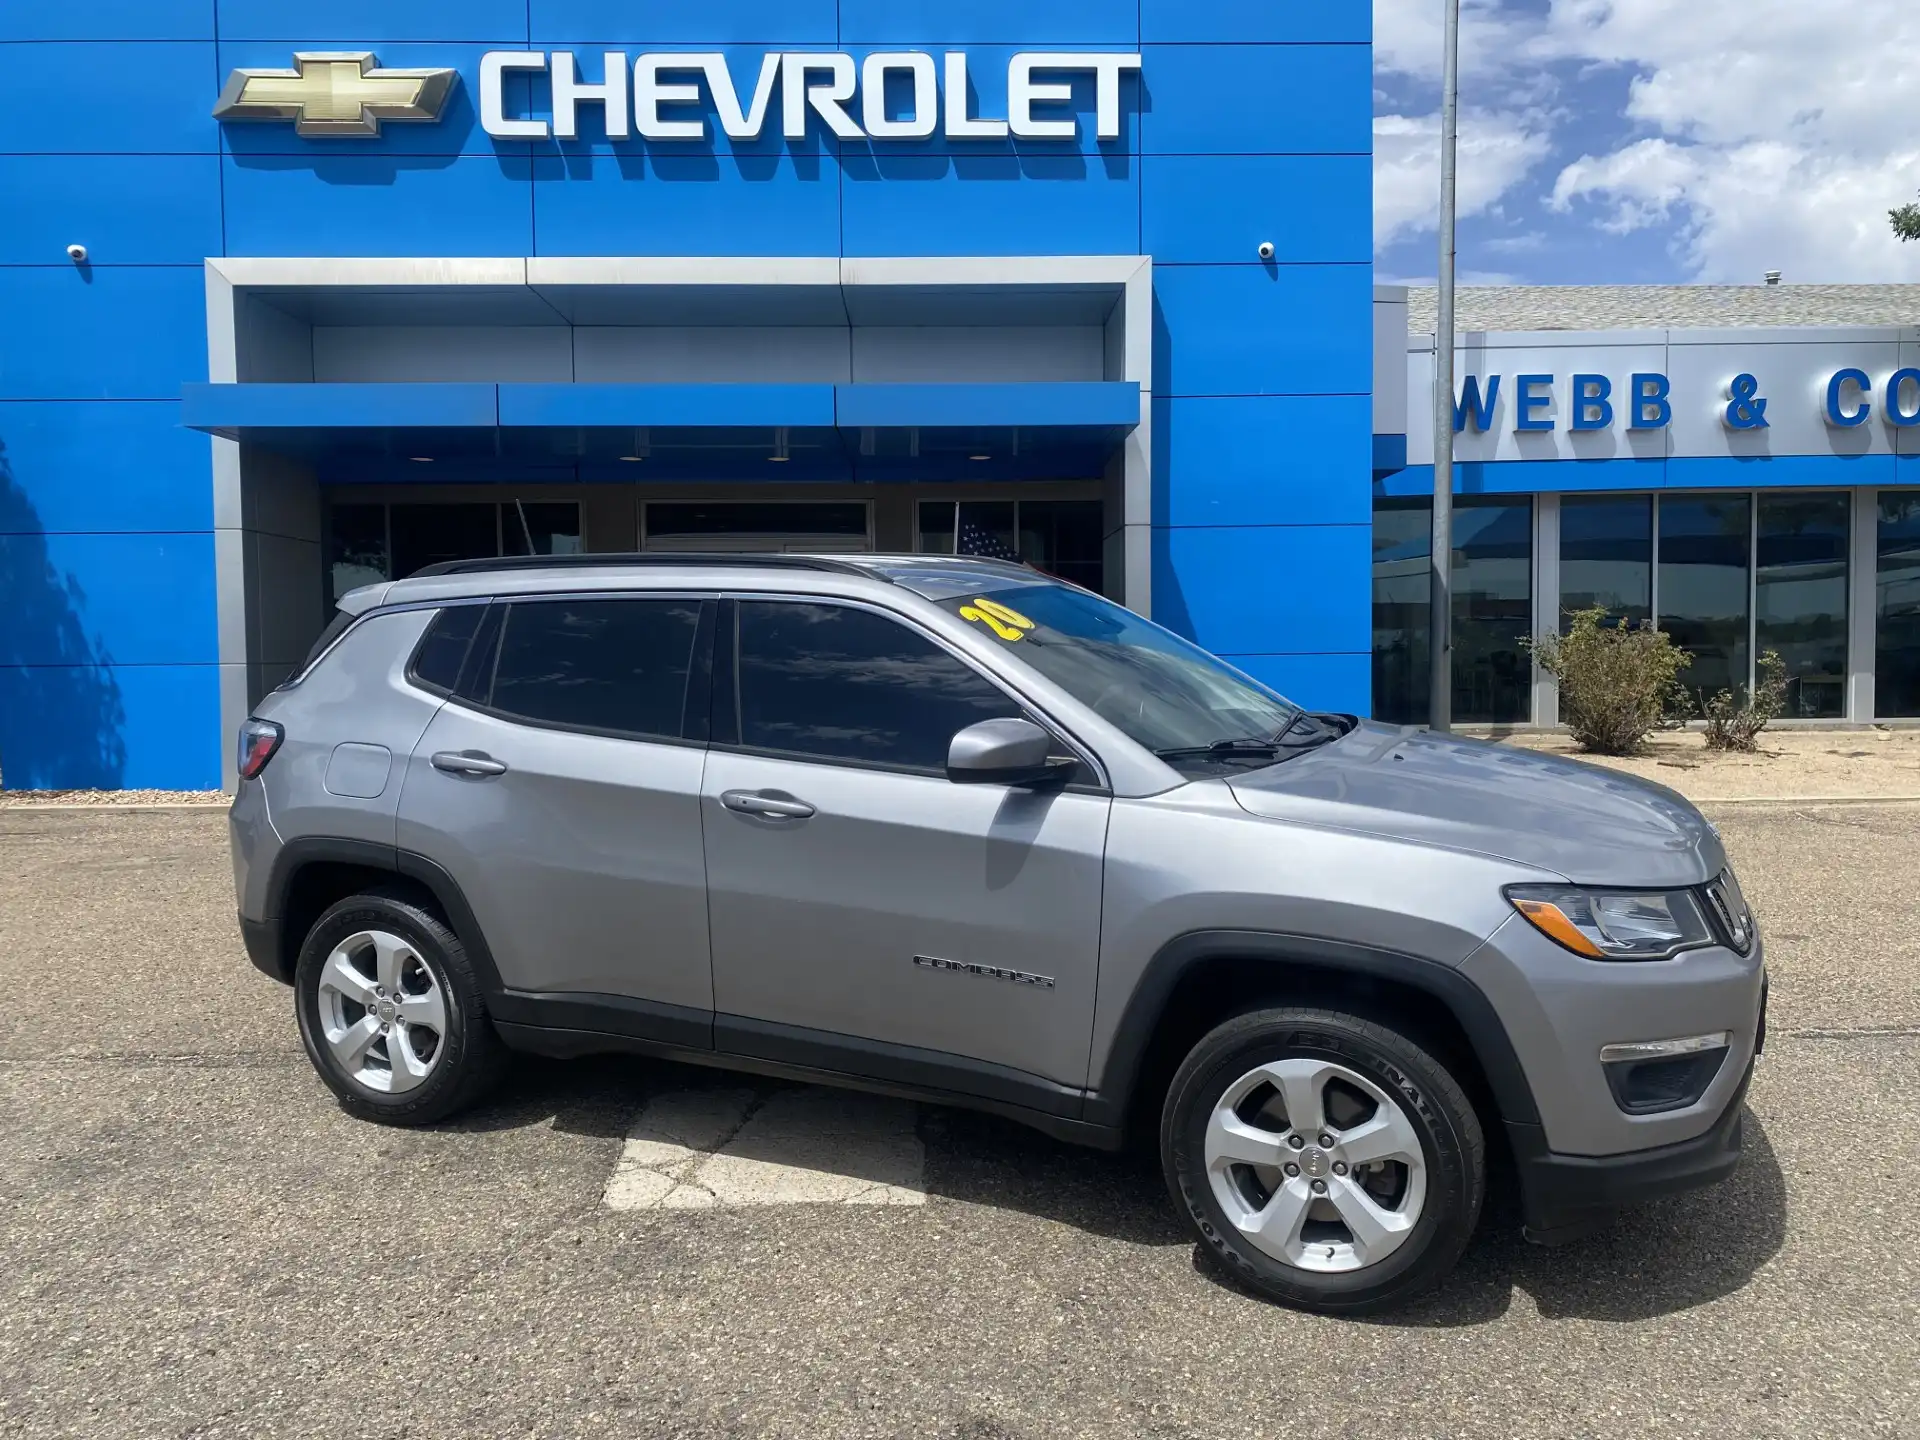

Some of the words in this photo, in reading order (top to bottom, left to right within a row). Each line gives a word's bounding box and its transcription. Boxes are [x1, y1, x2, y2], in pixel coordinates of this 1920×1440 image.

[479, 50, 1142, 140] CHEVROLET
[1452, 373, 1671, 432] WEBB
[1723, 373, 1770, 428] &
[1825, 368, 1920, 427] CO
[959, 598, 1036, 642] 20
[913, 954, 1056, 988] COMPASS
